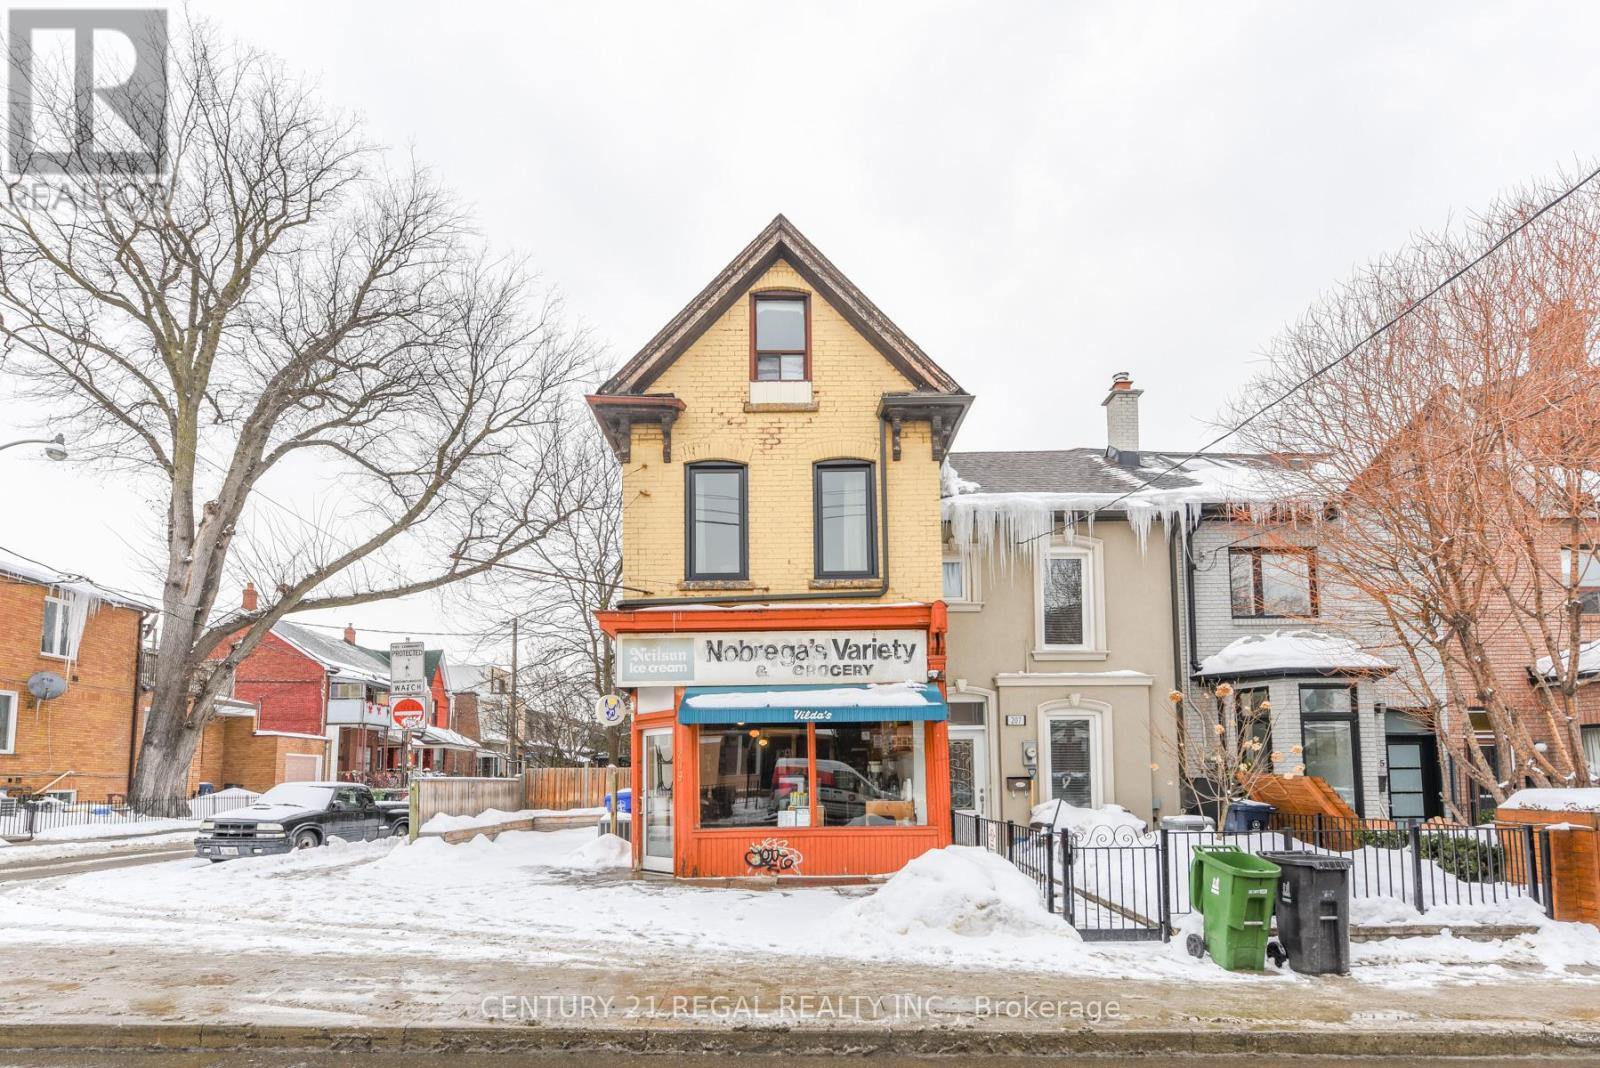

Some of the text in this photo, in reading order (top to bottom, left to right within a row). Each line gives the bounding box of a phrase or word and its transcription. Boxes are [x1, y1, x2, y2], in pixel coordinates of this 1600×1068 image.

[706, 638, 916, 667] Nobrega's Variety
[629, 662, 687, 673] Ice cream
[755, 664, 873, 677] & GROCERY
[793, 709, 832, 720] Vilda's
